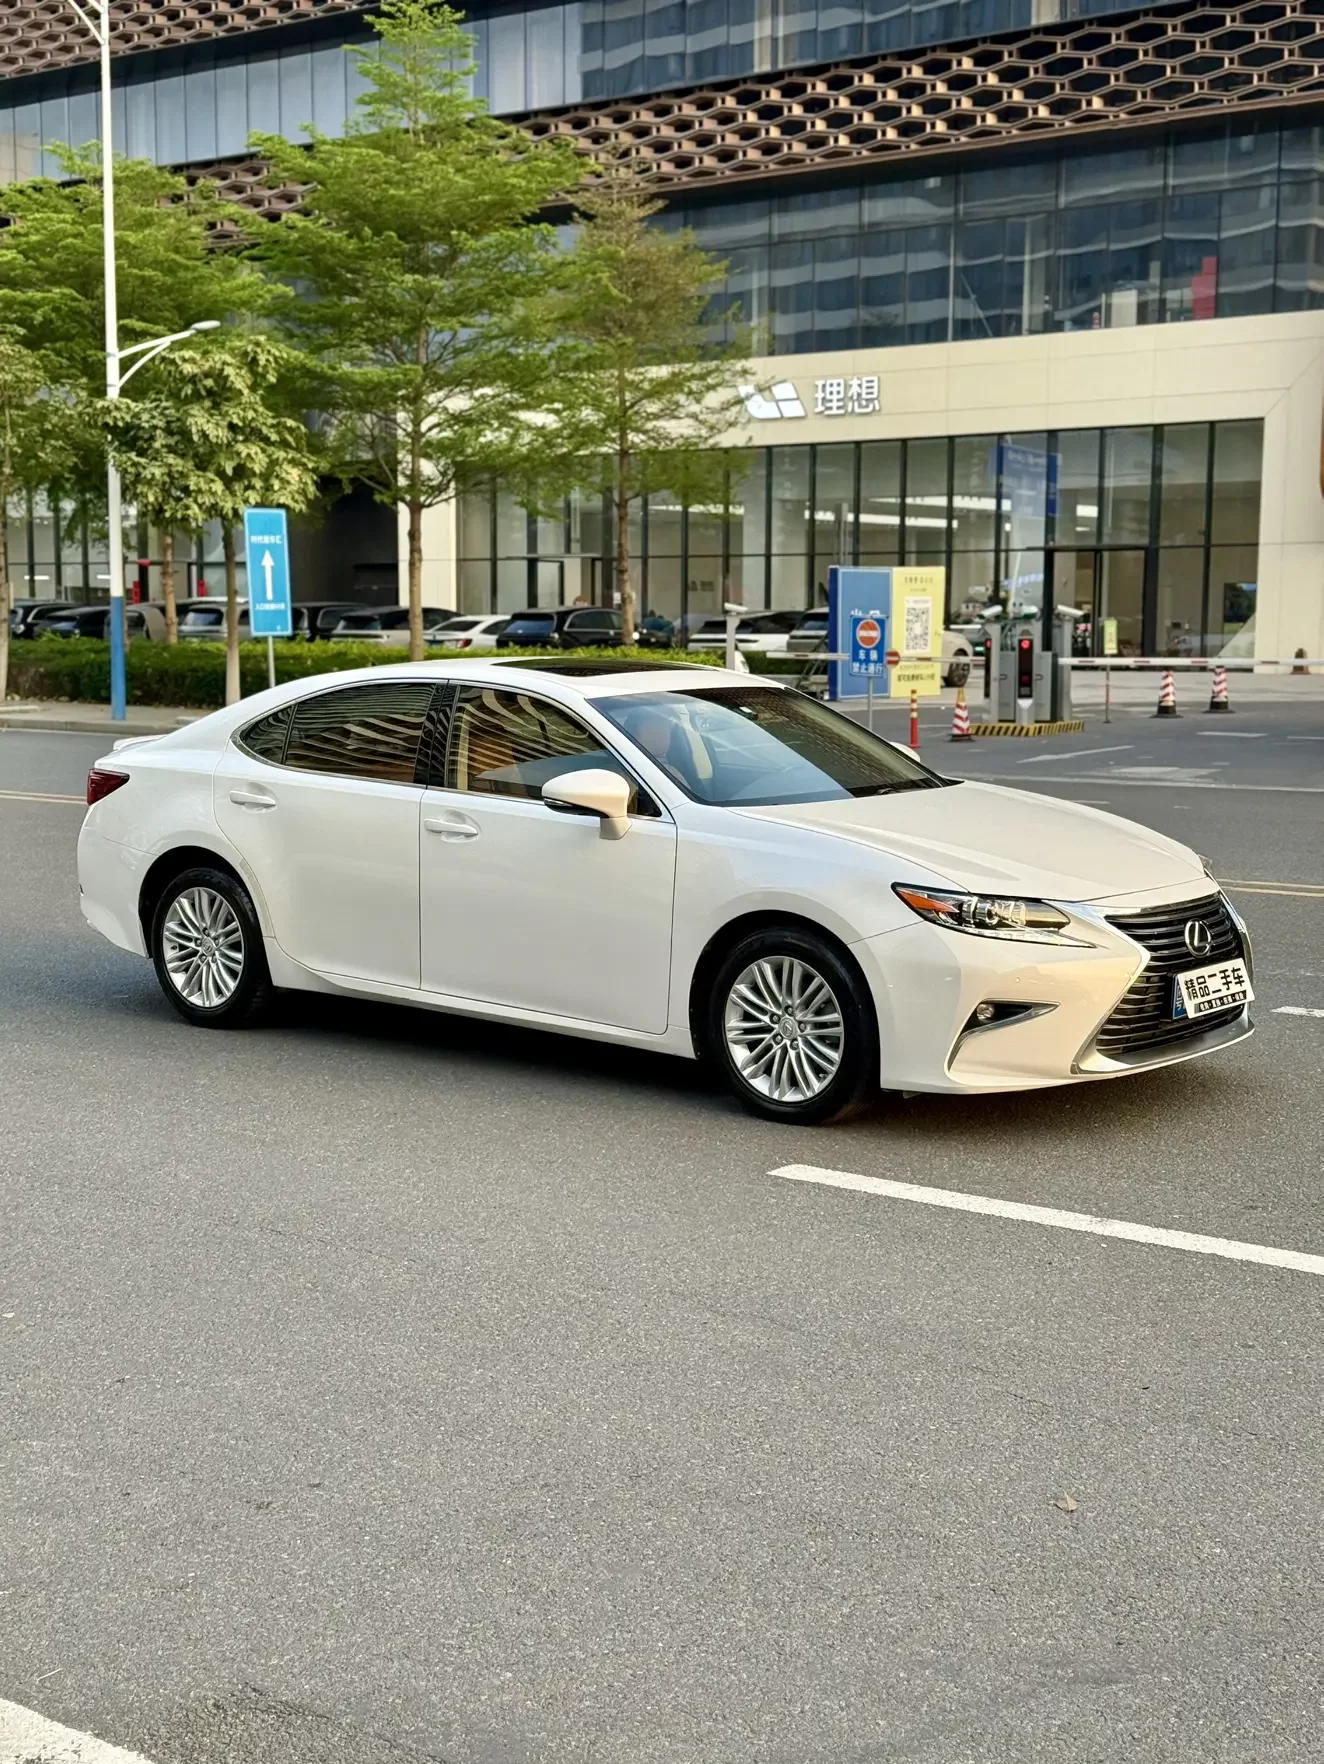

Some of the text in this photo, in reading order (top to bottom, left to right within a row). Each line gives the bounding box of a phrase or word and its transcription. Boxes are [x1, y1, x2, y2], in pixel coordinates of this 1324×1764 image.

[814, 375, 881, 415] 理想
[1184, 966, 1246, 1001] 精品二手车
